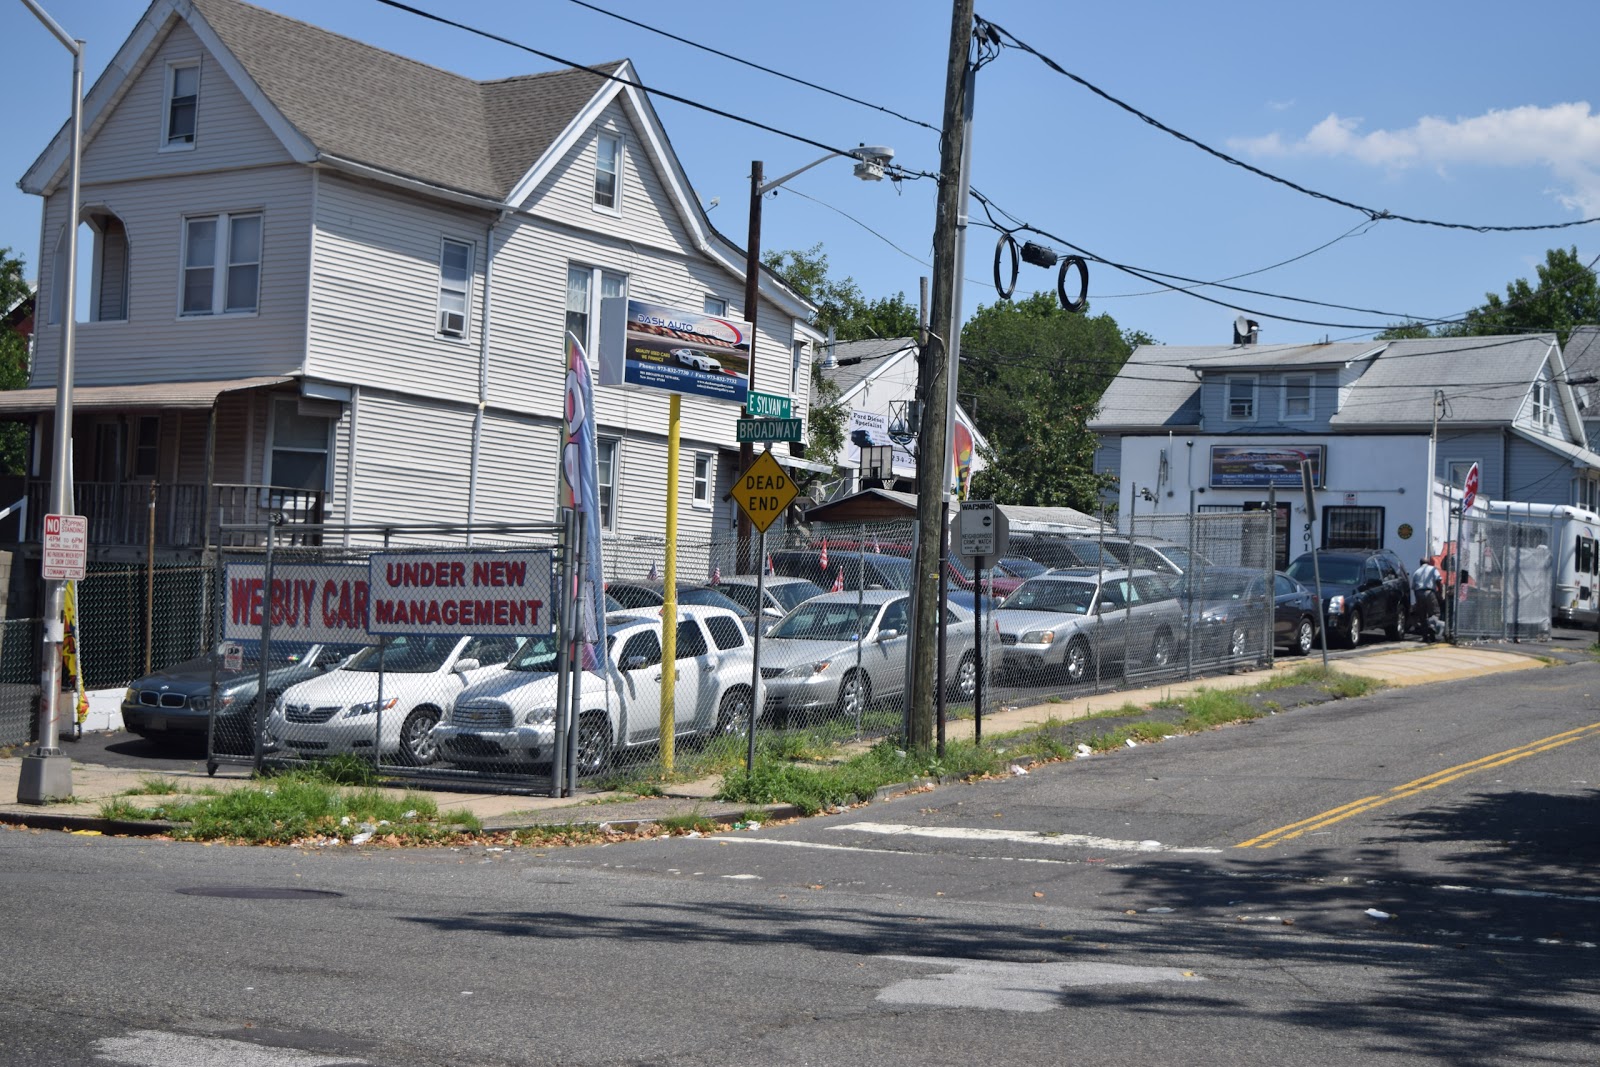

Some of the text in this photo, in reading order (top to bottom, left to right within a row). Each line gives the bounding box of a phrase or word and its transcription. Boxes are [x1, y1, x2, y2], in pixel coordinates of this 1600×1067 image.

[638, 314, 664, 327] DASH
[667, 320, 693, 332] AUTO
[750, 394, 788, 416] E SYLVAN AV
[855, 420, 882, 429] Specialist
[868, 415, 884, 423] Diesel
[740, 422, 798, 438] BROADWAY
[746, 476, 784, 490] DEAD
[750, 496, 778, 510] END
[47, 519, 60, 532] NO
[62, 520, 84, 528] STOPPING
[386, 561, 526, 588] UNDER NEW
[231, 578, 369, 630] WE BUY CAR
[376, 600, 543, 626] MANAGEMENT
